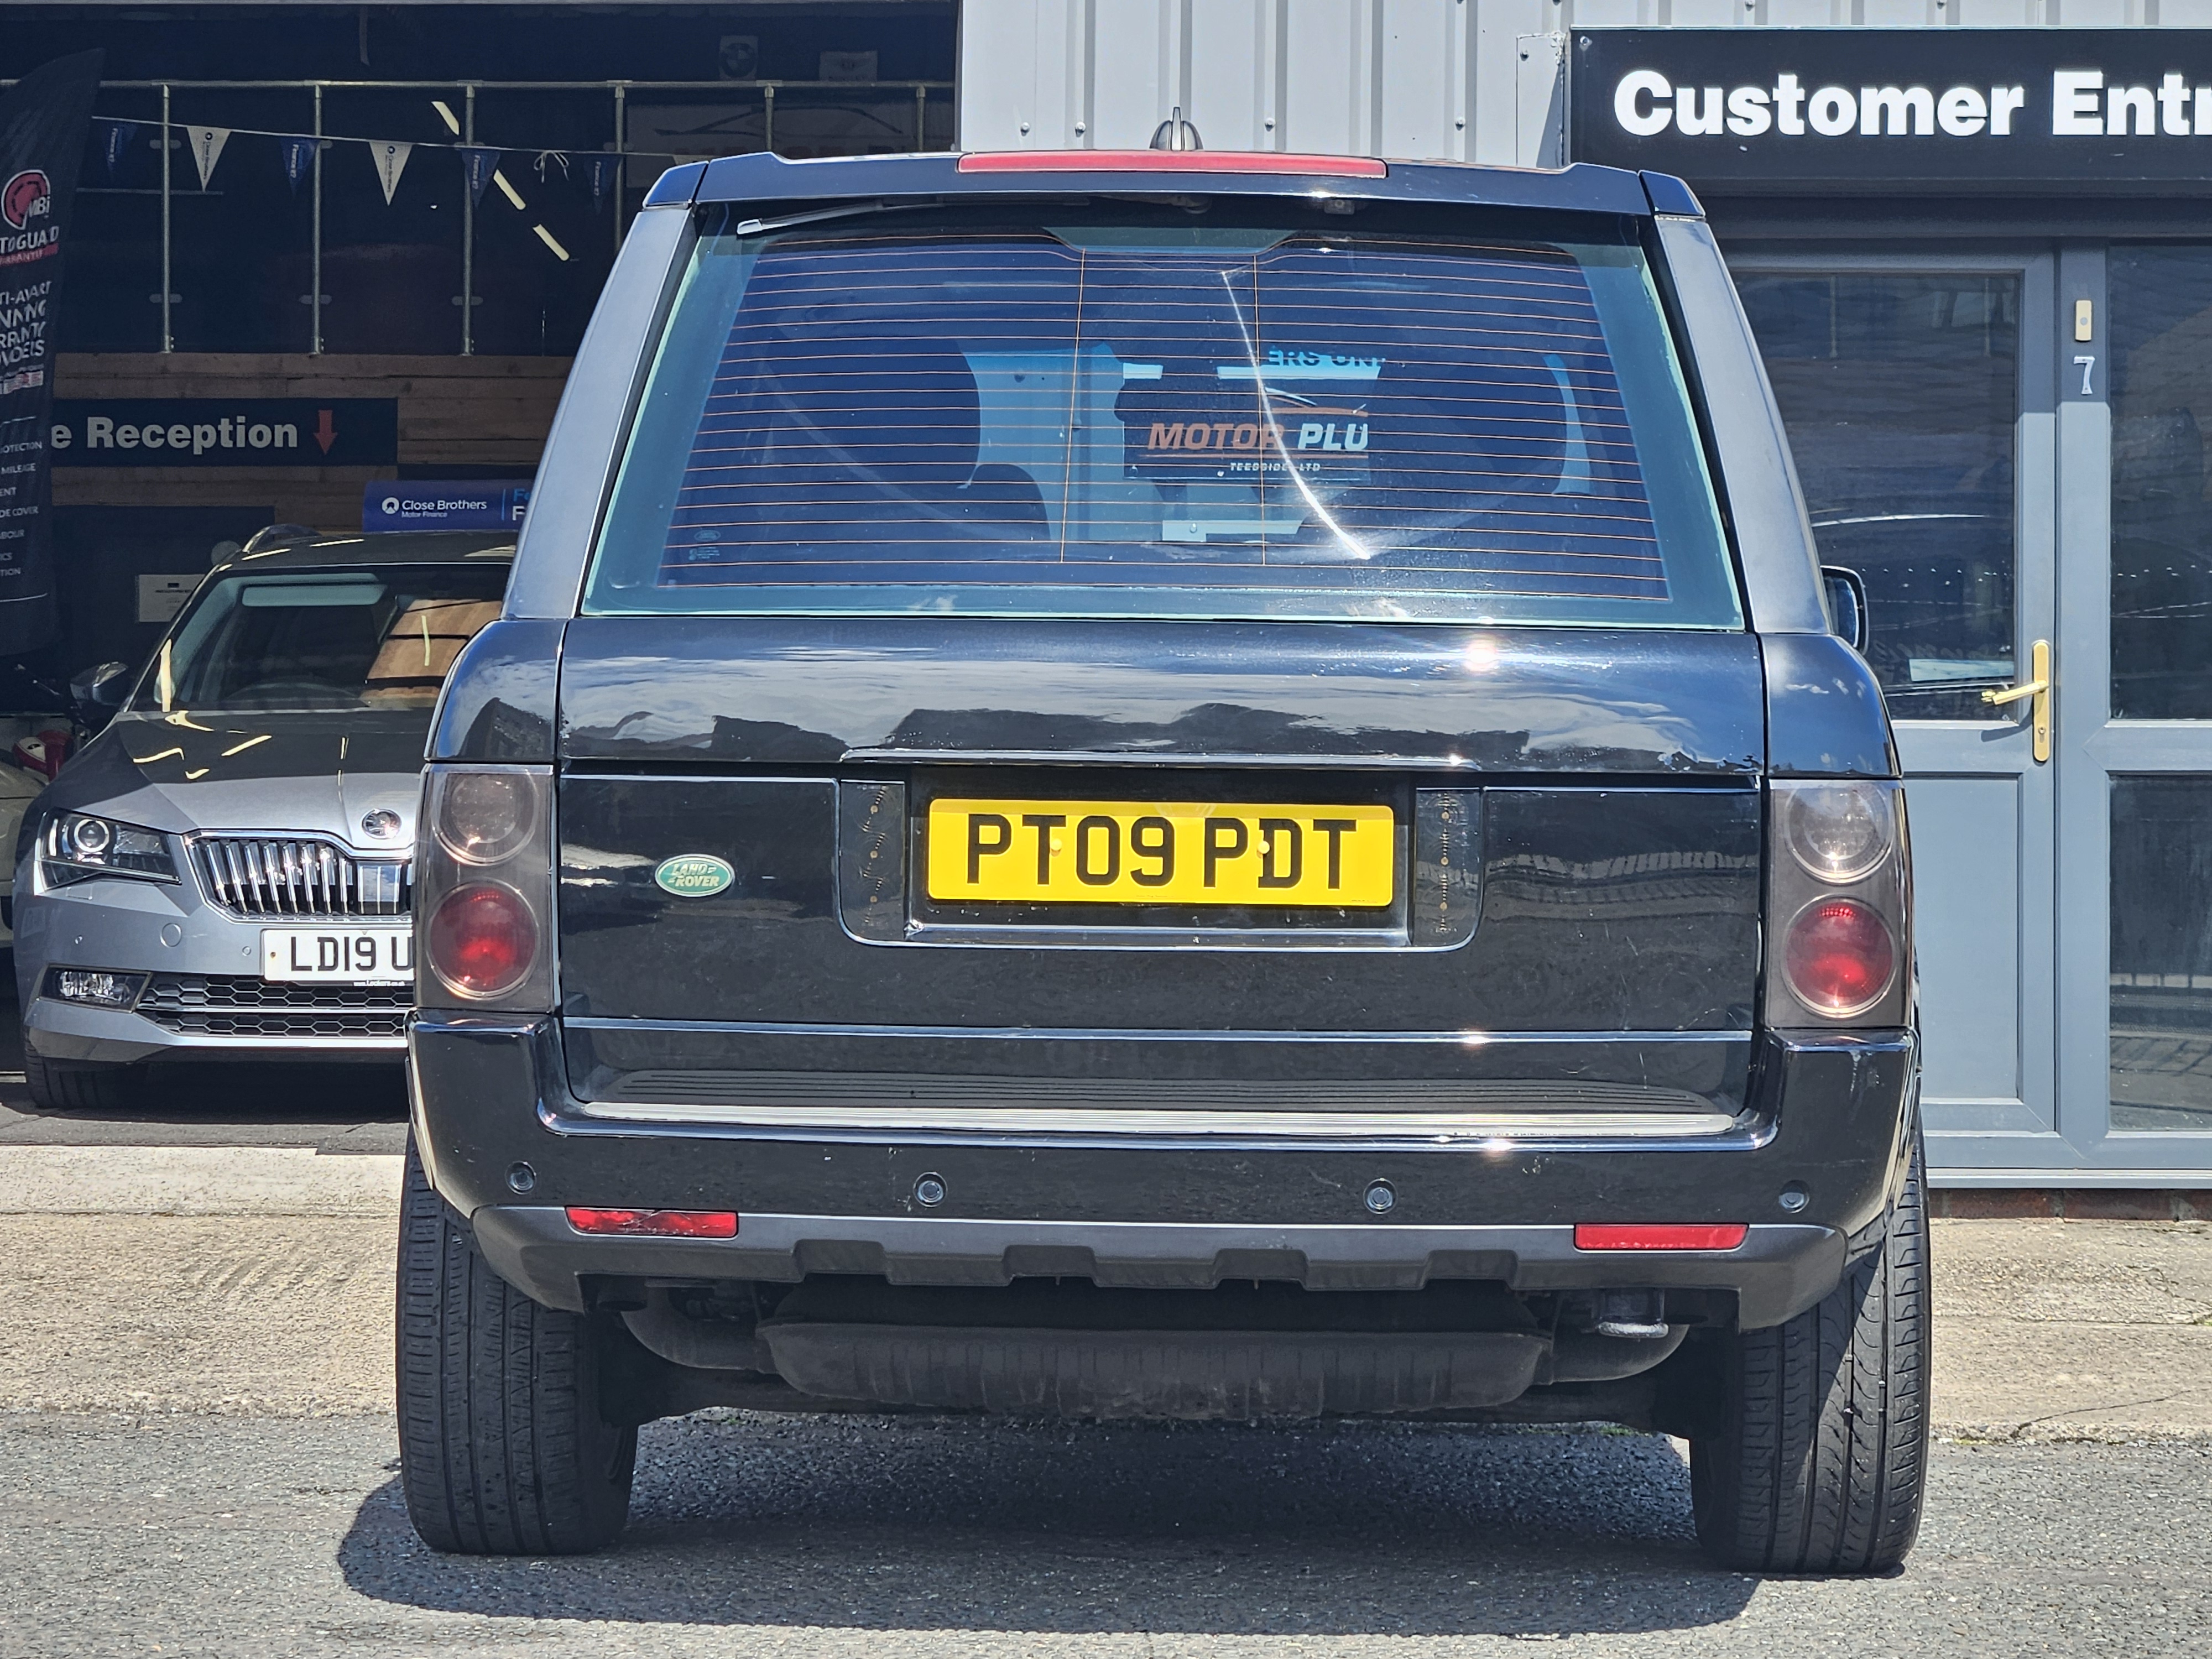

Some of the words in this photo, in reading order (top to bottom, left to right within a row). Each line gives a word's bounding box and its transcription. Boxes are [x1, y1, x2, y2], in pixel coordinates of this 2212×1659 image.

[1614, 70, 2024, 136] Customer
[2053, 71, 2212, 136] Entr
[2074, 356, 2095, 394] 7
[51, 425, 72, 448] e
[87, 416, 298, 455] Reception
[1147, 423, 1284, 450] MOTOR
[1298, 423, 1368, 451] PLU
[401, 500, 435, 511] Close
[437, 499, 487, 510] Brothers
[671, 863, 708, 876] LAND
[967, 813, 1175, 886] PT09
[1203, 817, 1357, 890] PDT
[675, 875, 720, 887] ROVER
[291, 936, 377, 972] LD19
[391, 936, 414, 971] U
